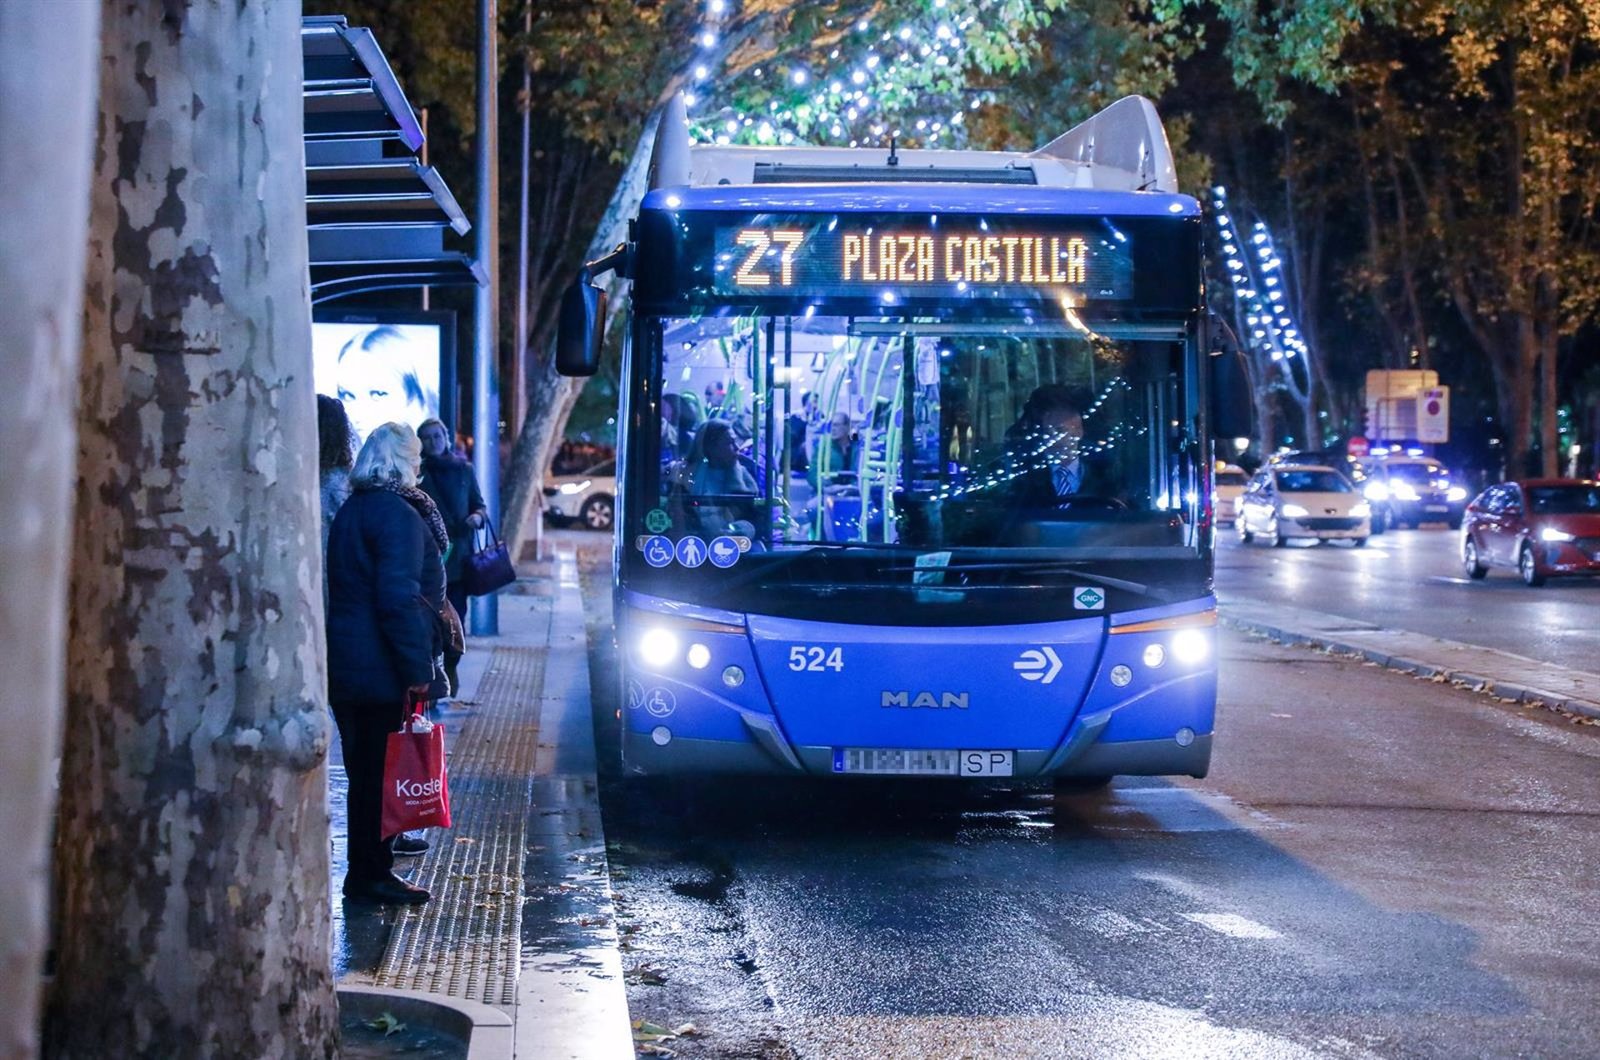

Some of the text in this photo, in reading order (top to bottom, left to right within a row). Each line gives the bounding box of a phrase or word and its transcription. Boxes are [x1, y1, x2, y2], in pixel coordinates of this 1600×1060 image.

[736, 230, 1086, 285] 27 PLAZA CASTILLA
[1080, 594, 1098, 602] GNC
[788, 646, 844, 672] 524
[880, 691, 969, 708] MAN
[967, 753, 1006, 773] SP
